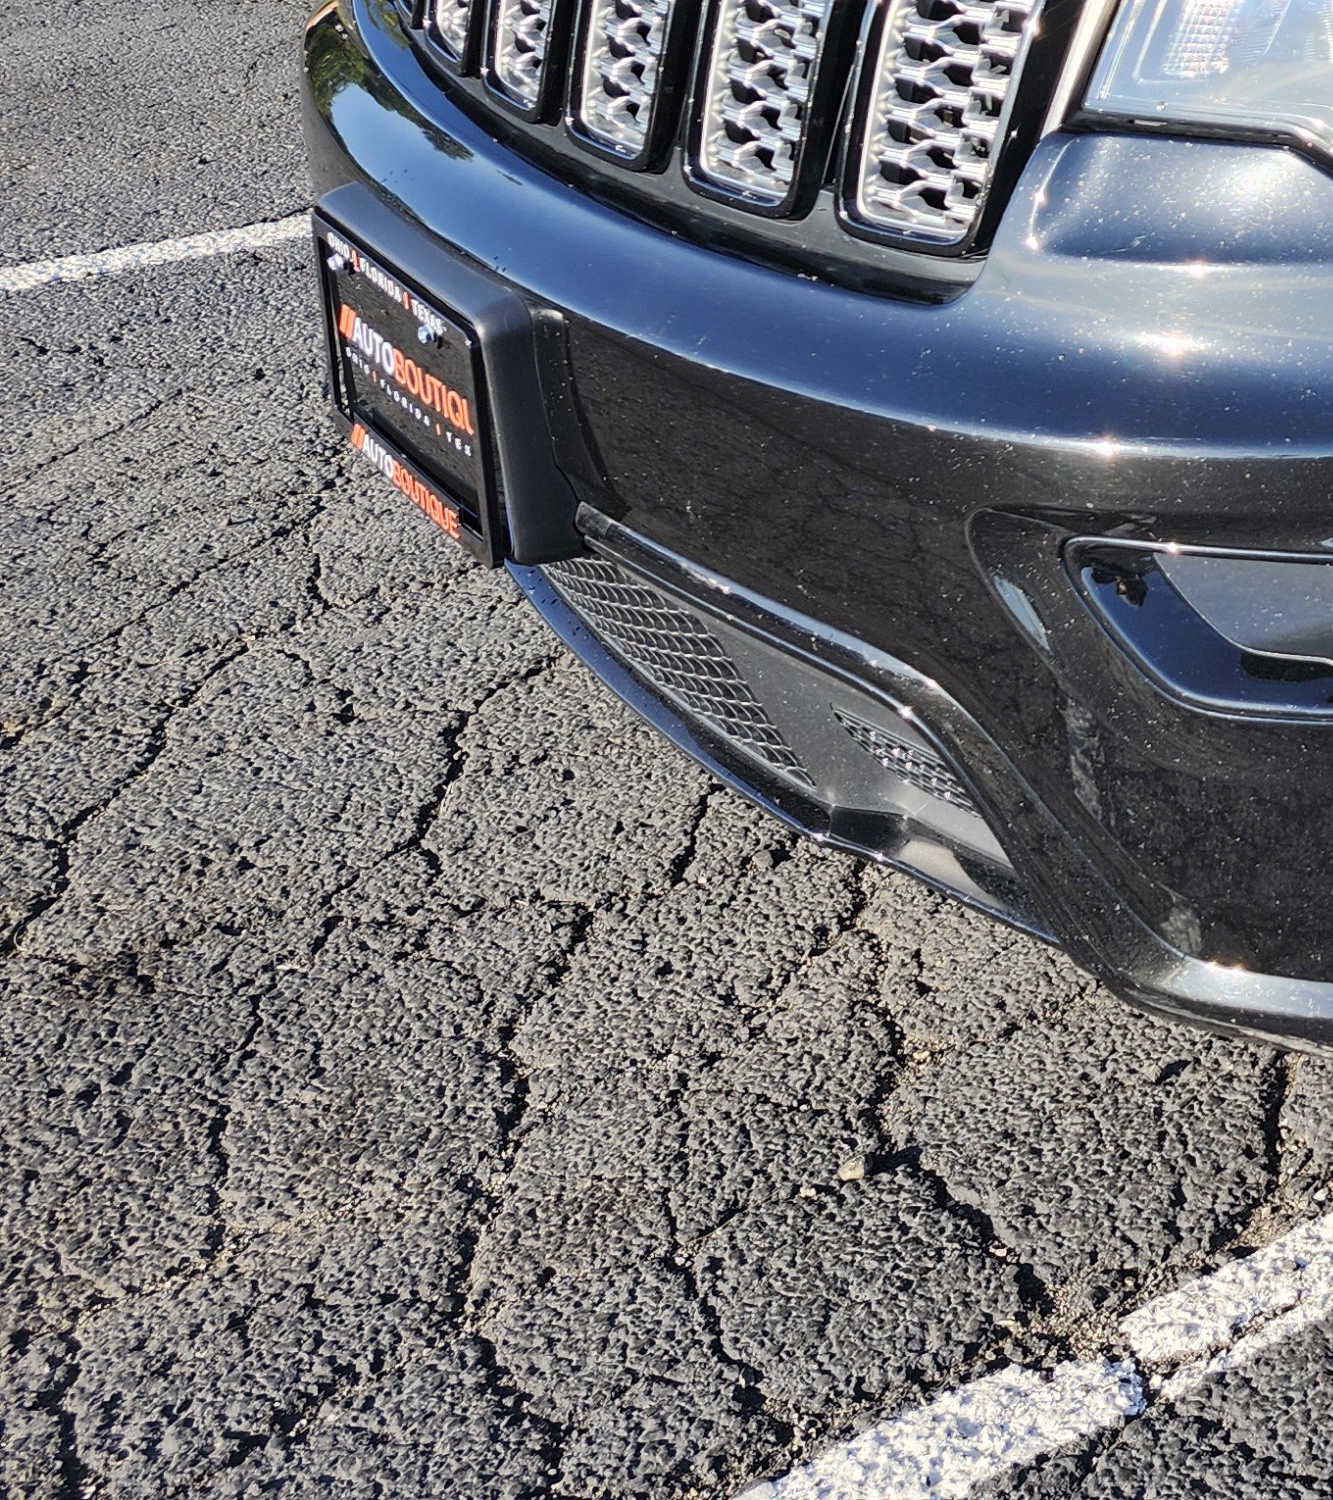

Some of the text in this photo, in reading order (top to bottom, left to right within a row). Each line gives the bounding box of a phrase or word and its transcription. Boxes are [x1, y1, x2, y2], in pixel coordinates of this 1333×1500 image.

[326, 231, 351, 260] OHIO
[359, 256, 402, 303] FLORIDA
[345, 346, 371, 376] OHIO
[380, 378, 431, 427] FLORIDA
[363, 433, 461, 539] AUTOBOUTIQUE
